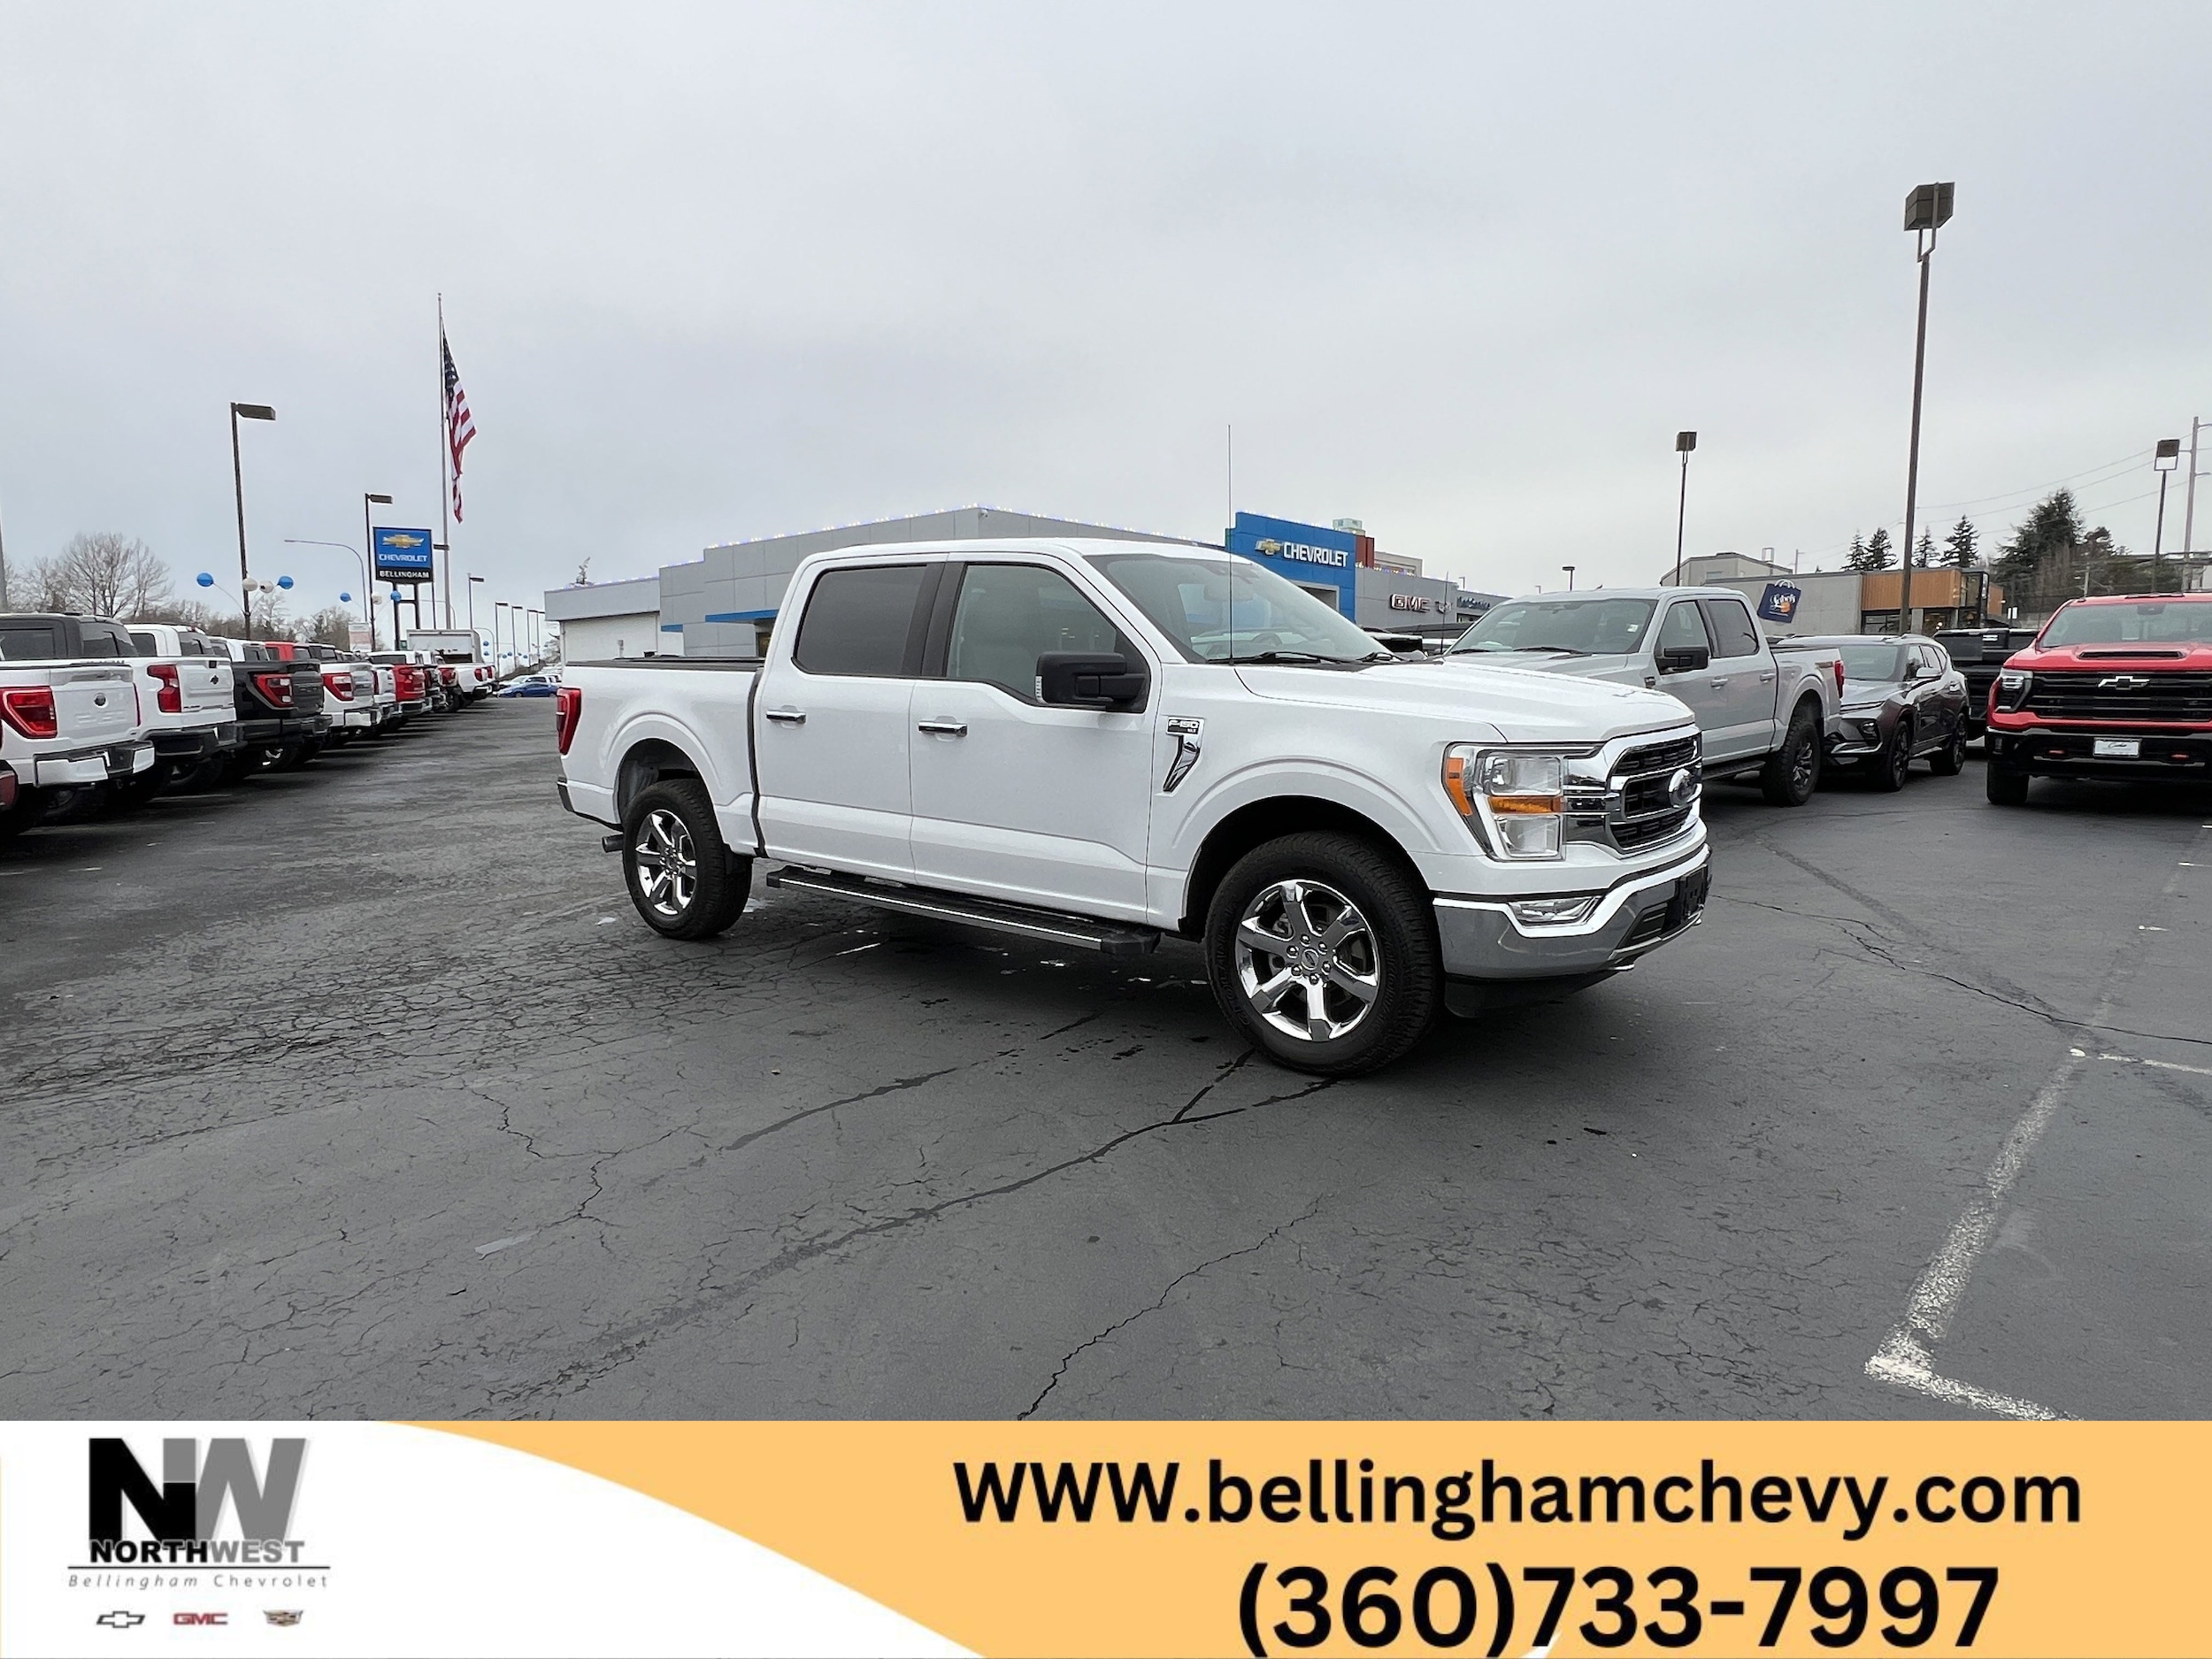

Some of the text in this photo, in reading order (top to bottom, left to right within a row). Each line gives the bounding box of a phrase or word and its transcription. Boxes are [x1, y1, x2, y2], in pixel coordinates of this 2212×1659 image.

[1283, 541, 1348, 567] CHEVROLET
[1390, 593, 1431, 613] GMC
[1169, 719, 1199, 728] F-150
